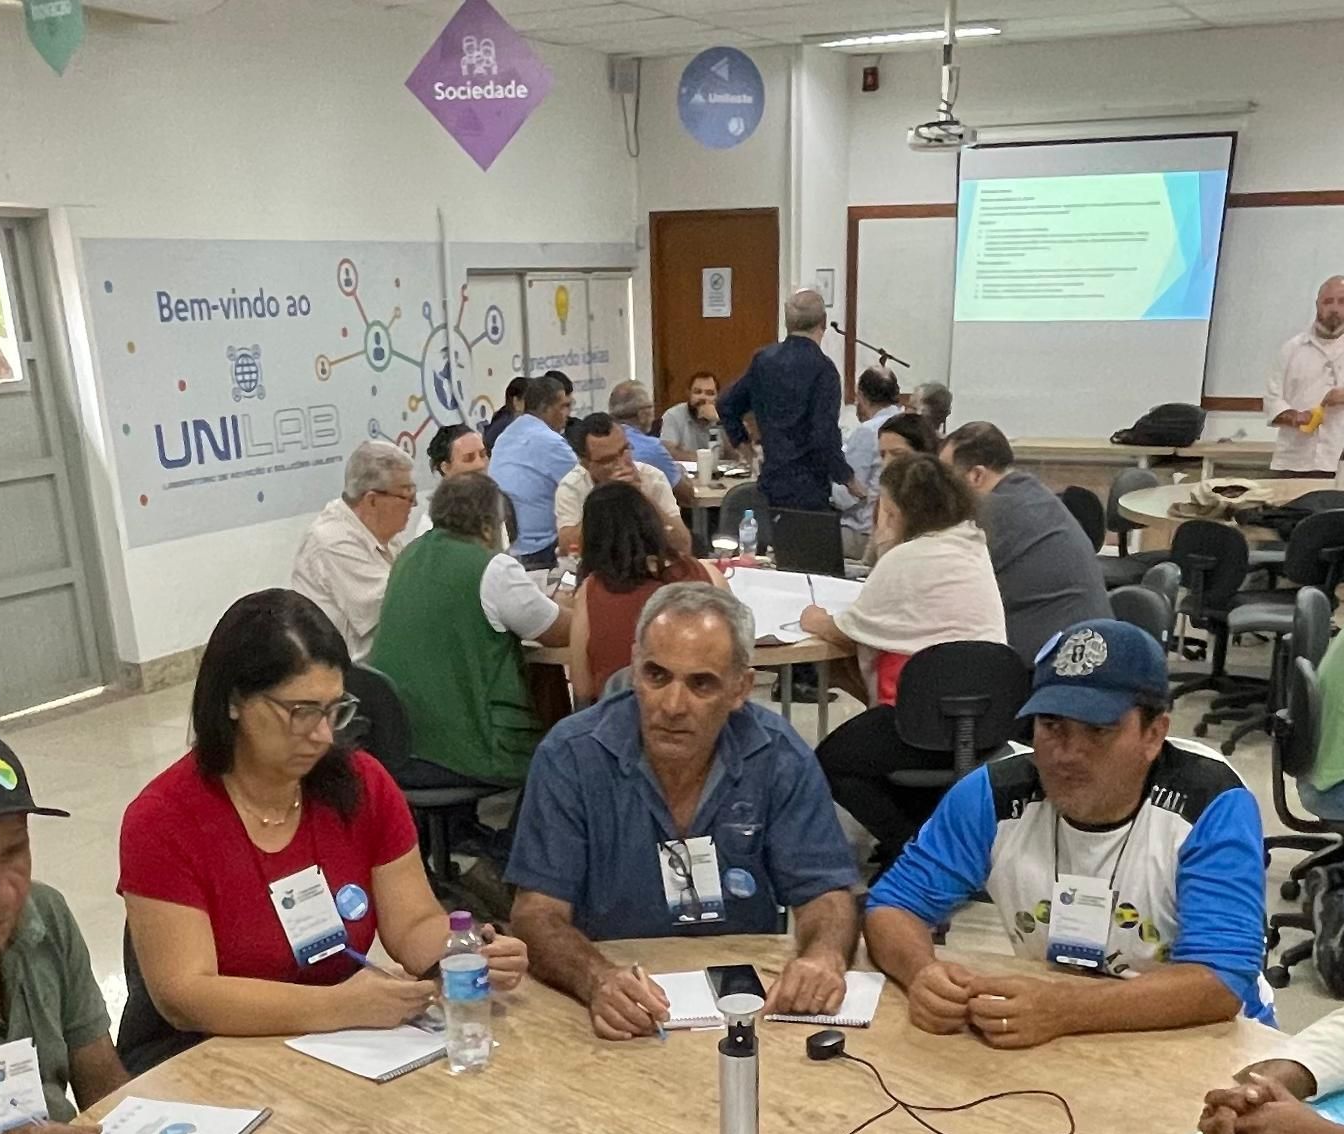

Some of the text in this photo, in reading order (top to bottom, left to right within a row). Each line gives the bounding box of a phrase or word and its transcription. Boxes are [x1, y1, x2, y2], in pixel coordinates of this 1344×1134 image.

[434, 81, 528, 101] Sociedade
[156, 287, 311, 322] Bem-vindo ao
[155, 404, 341, 469] UNILAB
